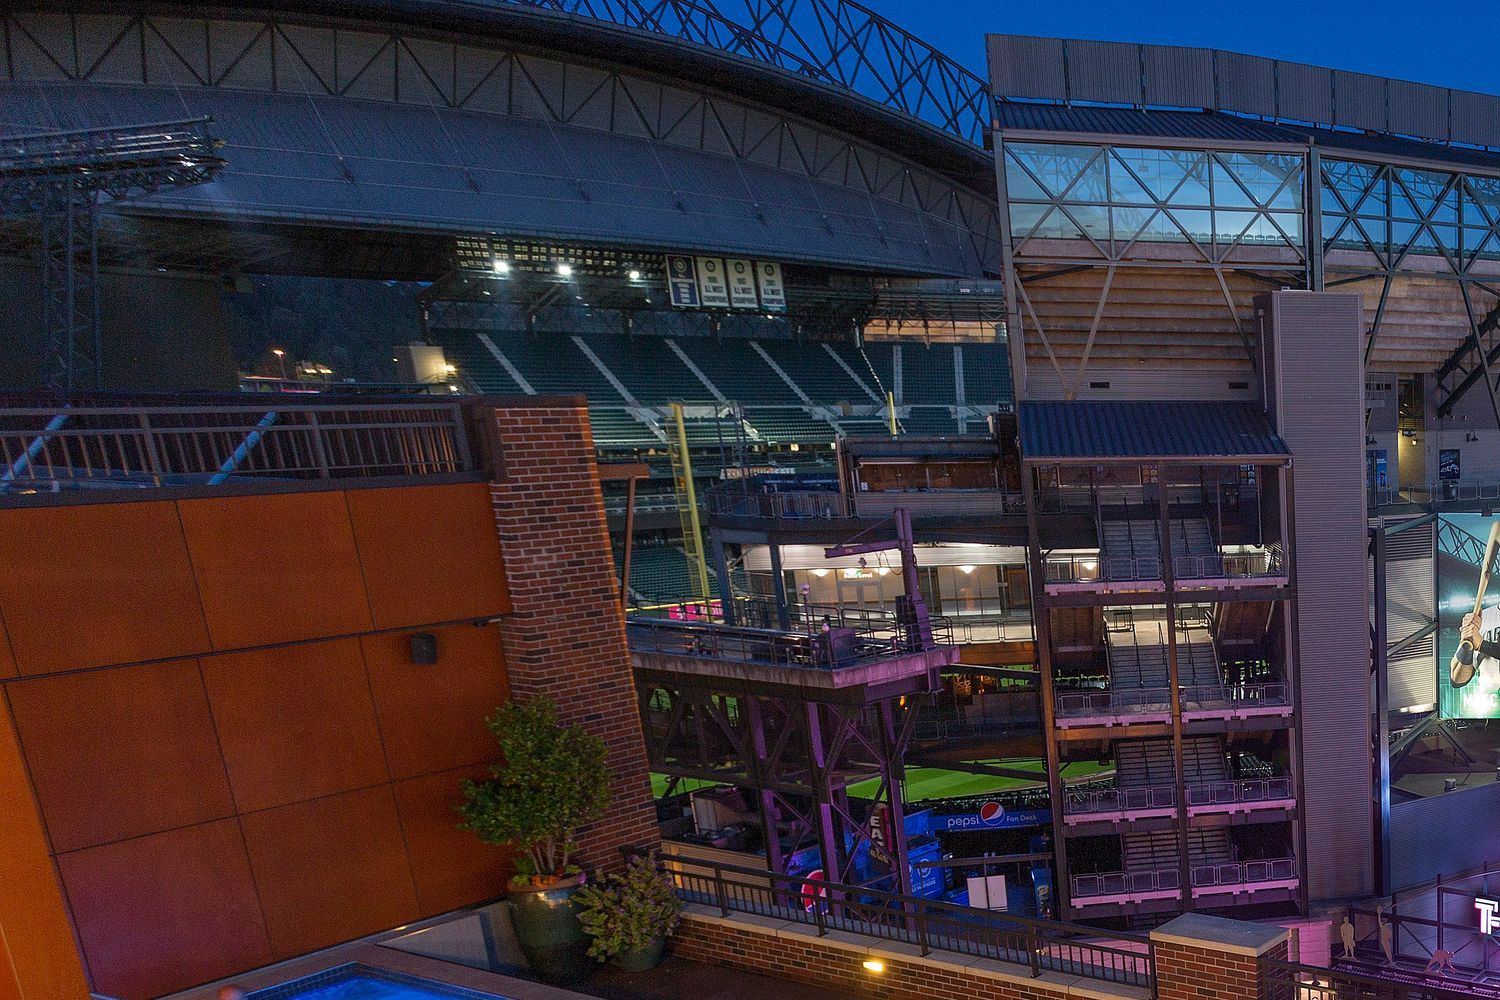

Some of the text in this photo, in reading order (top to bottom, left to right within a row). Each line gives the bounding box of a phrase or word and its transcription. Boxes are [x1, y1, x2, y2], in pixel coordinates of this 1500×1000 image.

[947, 814, 1038, 828] pepsi Fan Deck
